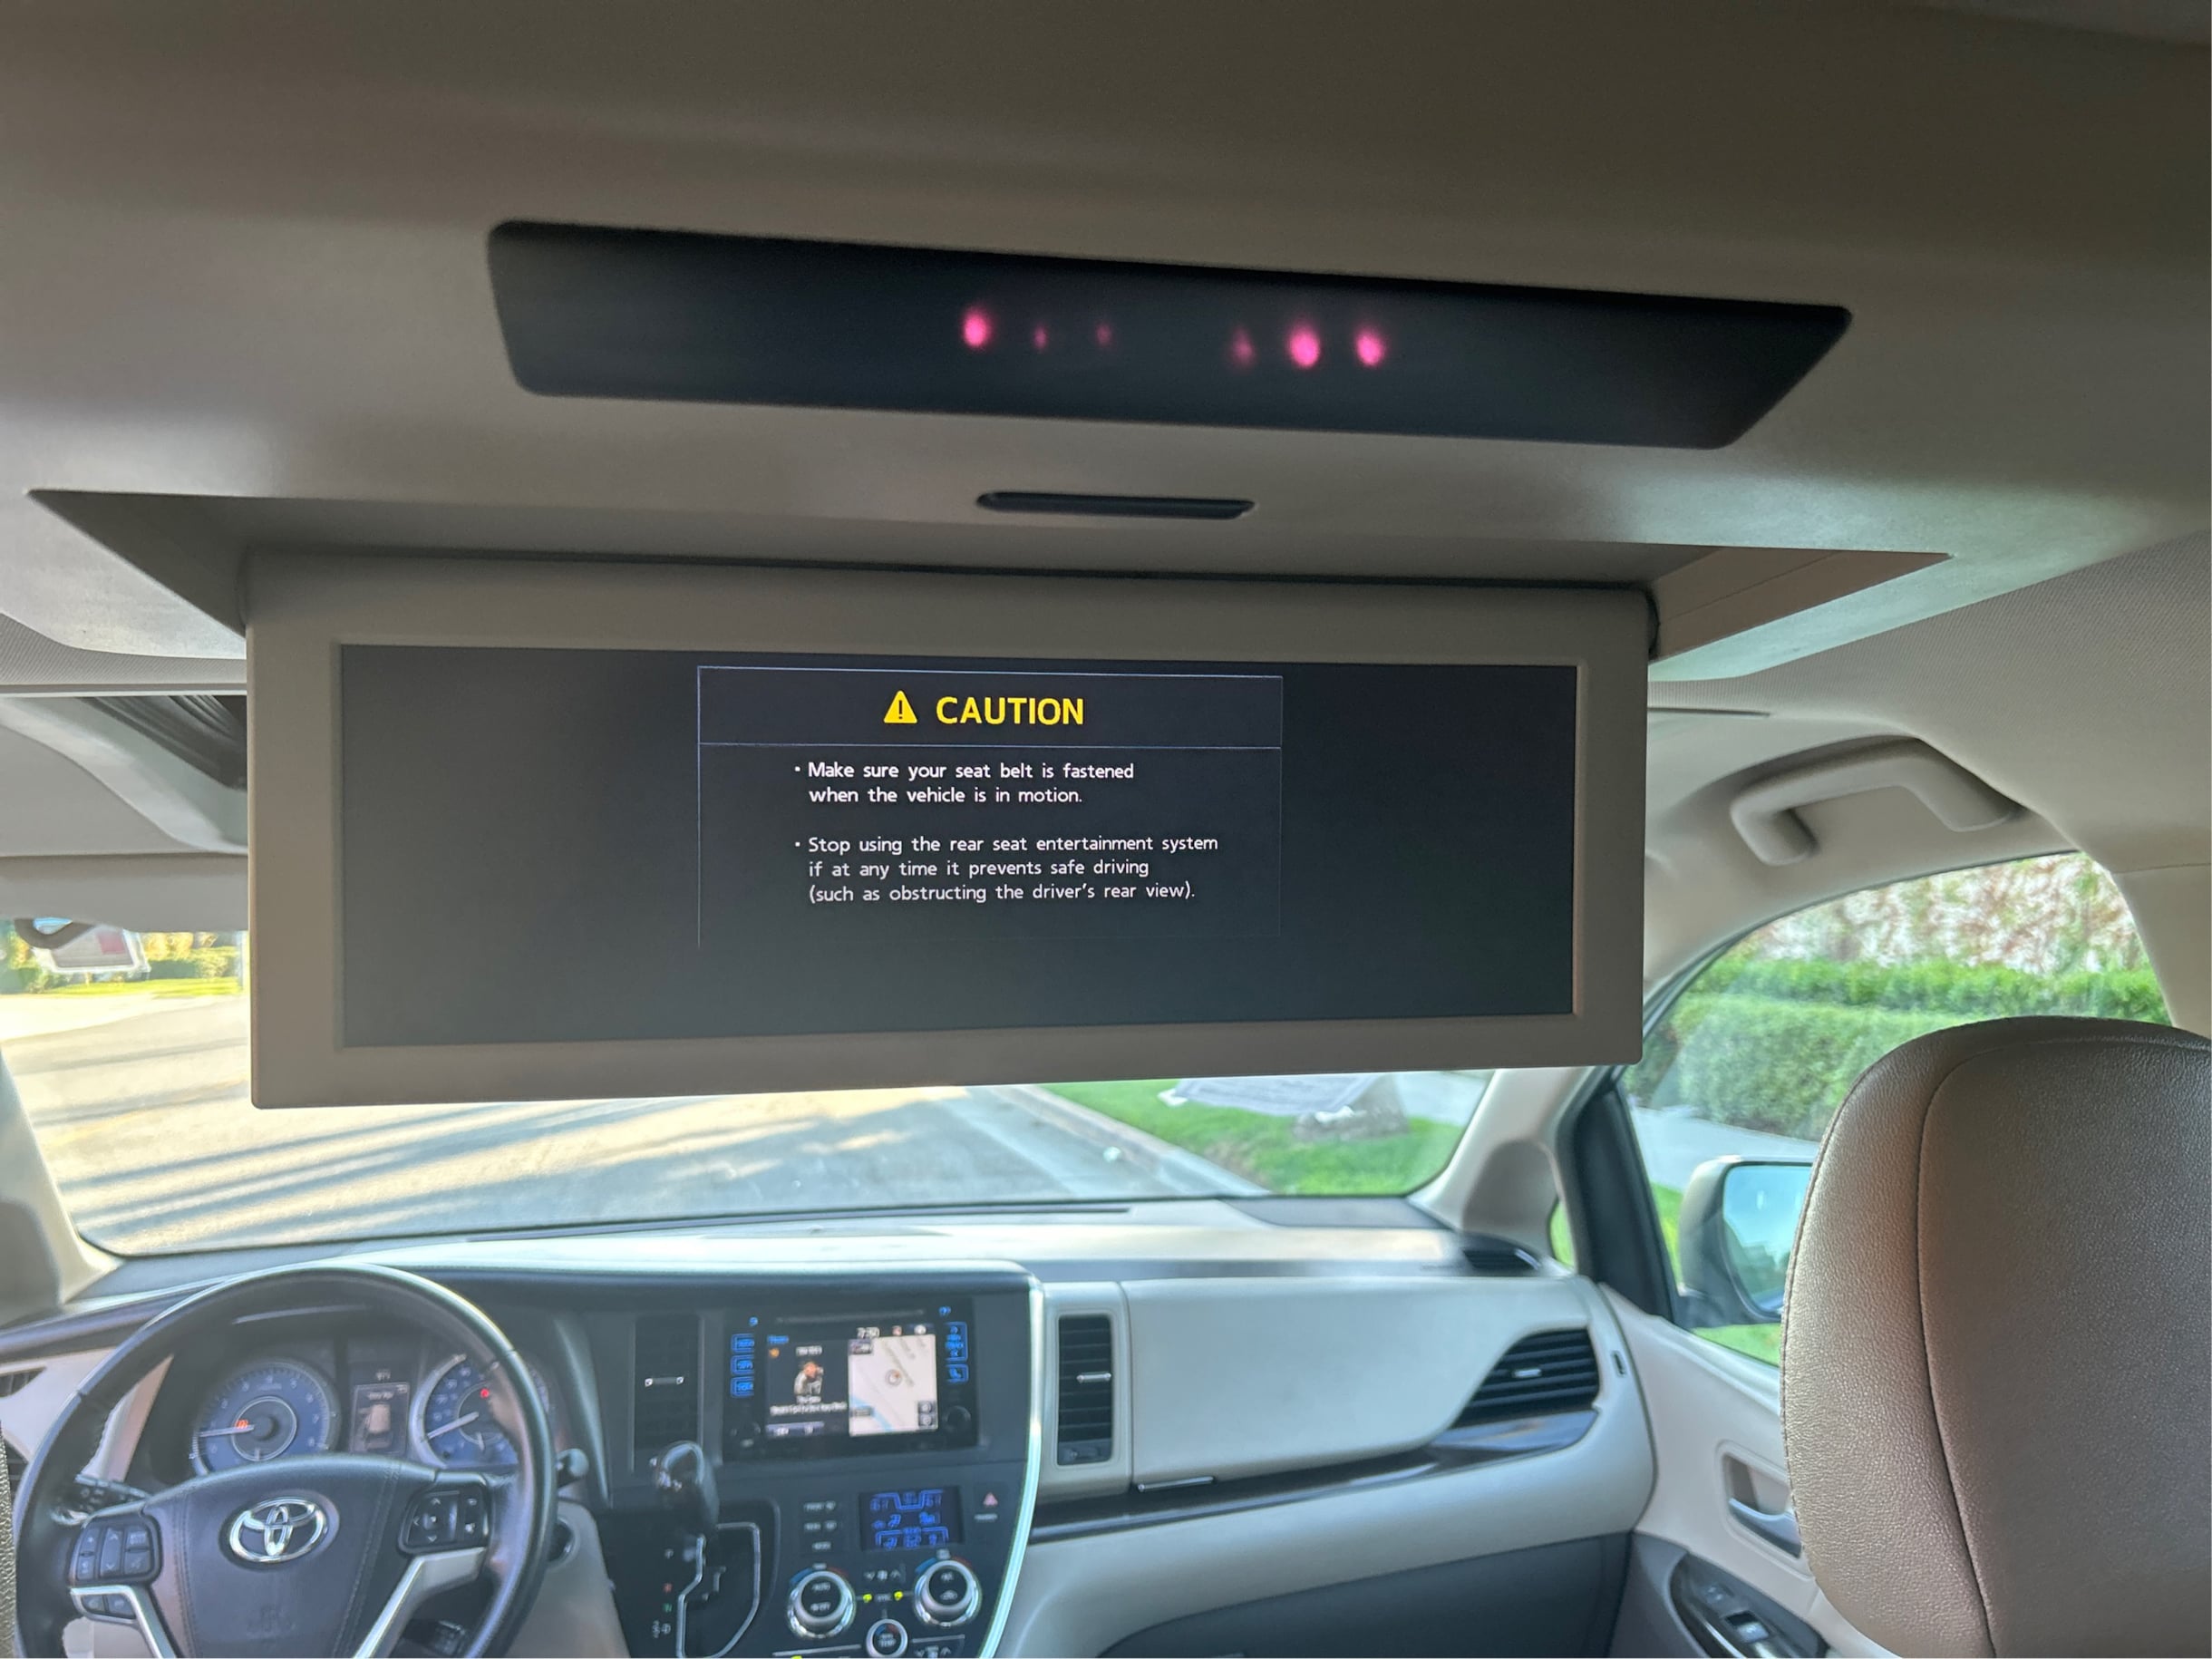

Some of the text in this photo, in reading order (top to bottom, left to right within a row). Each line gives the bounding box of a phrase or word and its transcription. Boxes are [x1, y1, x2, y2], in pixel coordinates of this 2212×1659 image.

[936, 695, 1084, 726] CAUTION
[808, 761, 1134, 783] Make sure your seat belt is fastened
[808, 785, 1083, 803] when the vehicle is in motion.
[808, 834, 1218, 857] Stop using the rear seat entertainment system
[809, 858, 1150, 880] if at any time it prevents safe driving
[809, 884, 854, 905] (such
[862, 888, 880, 902] as
[888, 884, 987, 905] obstructing
[994, 883, 1024, 899] the
[1103, 886, 1138, 899] rear
[1145, 879, 1196, 900] view).
